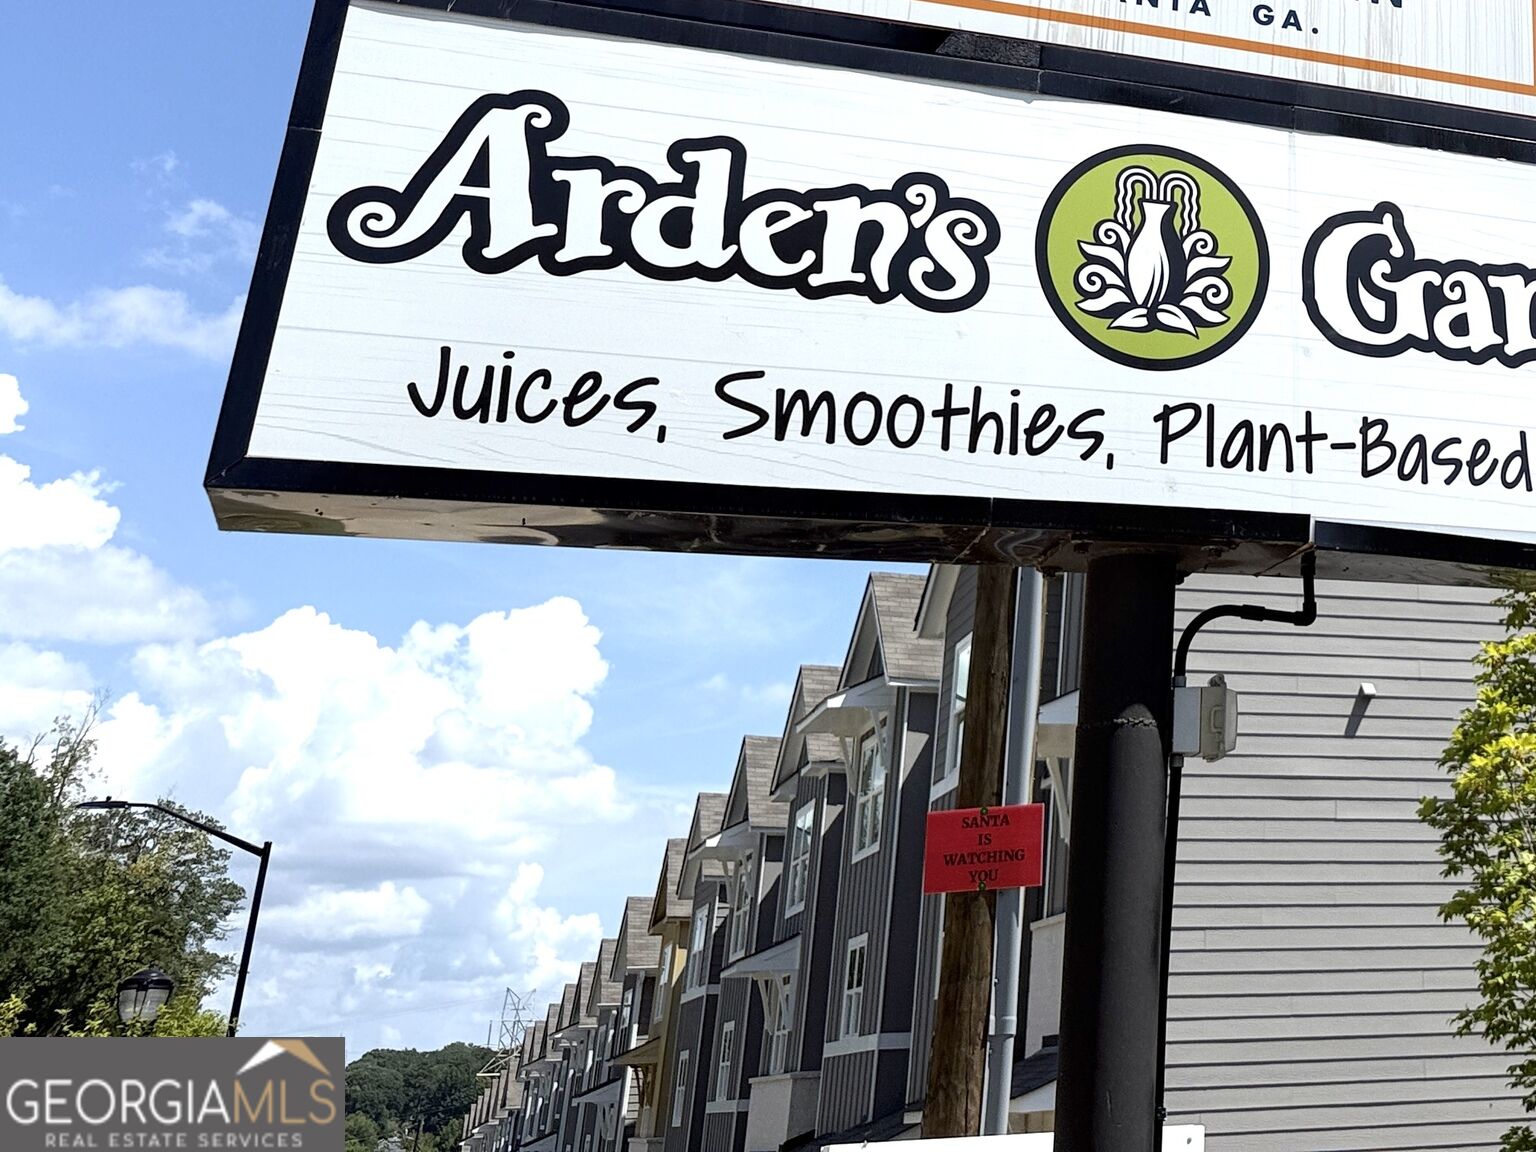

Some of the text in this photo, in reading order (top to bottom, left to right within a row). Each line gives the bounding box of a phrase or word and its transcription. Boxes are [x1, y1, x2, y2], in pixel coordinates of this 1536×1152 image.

[1252, 4, 1320, 35] GA.
[327, 89, 1002, 313] Arden's
[407, 346, 666, 445] Juices,
[714, 370, 1114, 470] Smoothies,
[1154, 402, 1532, 493] Plant-Based
[961, 814, 1010, 829] SANTA
[978, 833, 992, 846] IS
[943, 849, 1025, 866] WATCHING
[969, 869, 1000, 884] YOU
